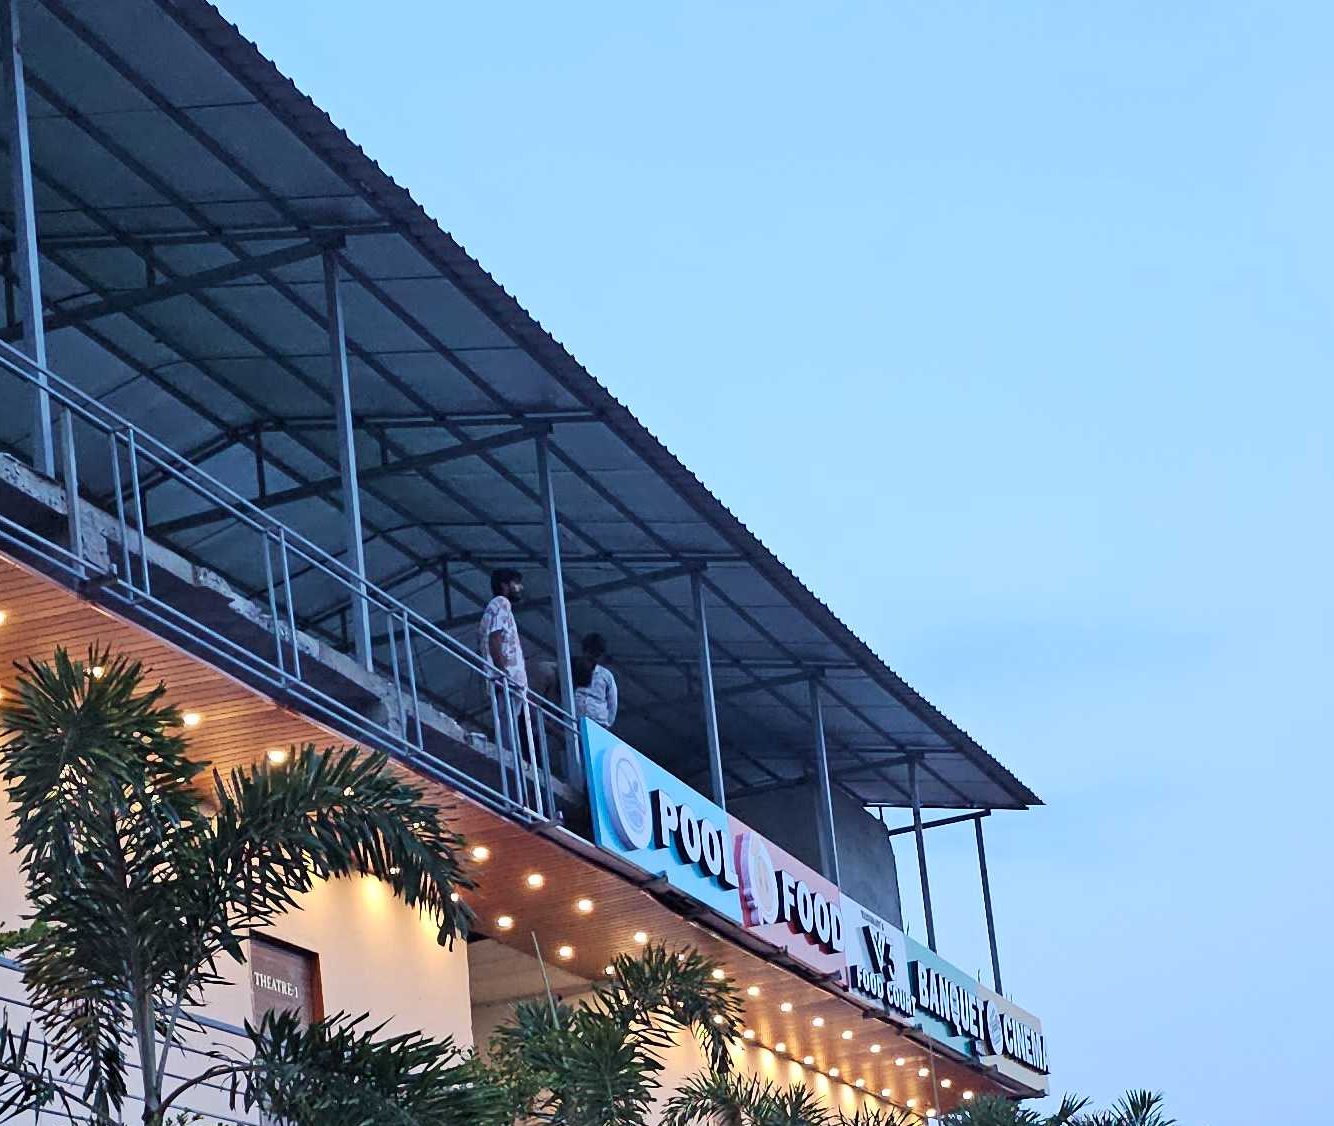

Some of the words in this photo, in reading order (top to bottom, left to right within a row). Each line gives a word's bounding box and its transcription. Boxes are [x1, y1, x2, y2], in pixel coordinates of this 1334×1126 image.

[654, 788, 739, 888] POOL
[779, 869, 845, 952] FOOD
[253, 971, 299, 999] THEATRE-1
[854, 964, 885, 1000] FOOD
[915, 960, 986, 1041] BANQUET
[1002, 1013, 1051, 1074] CINEMA
